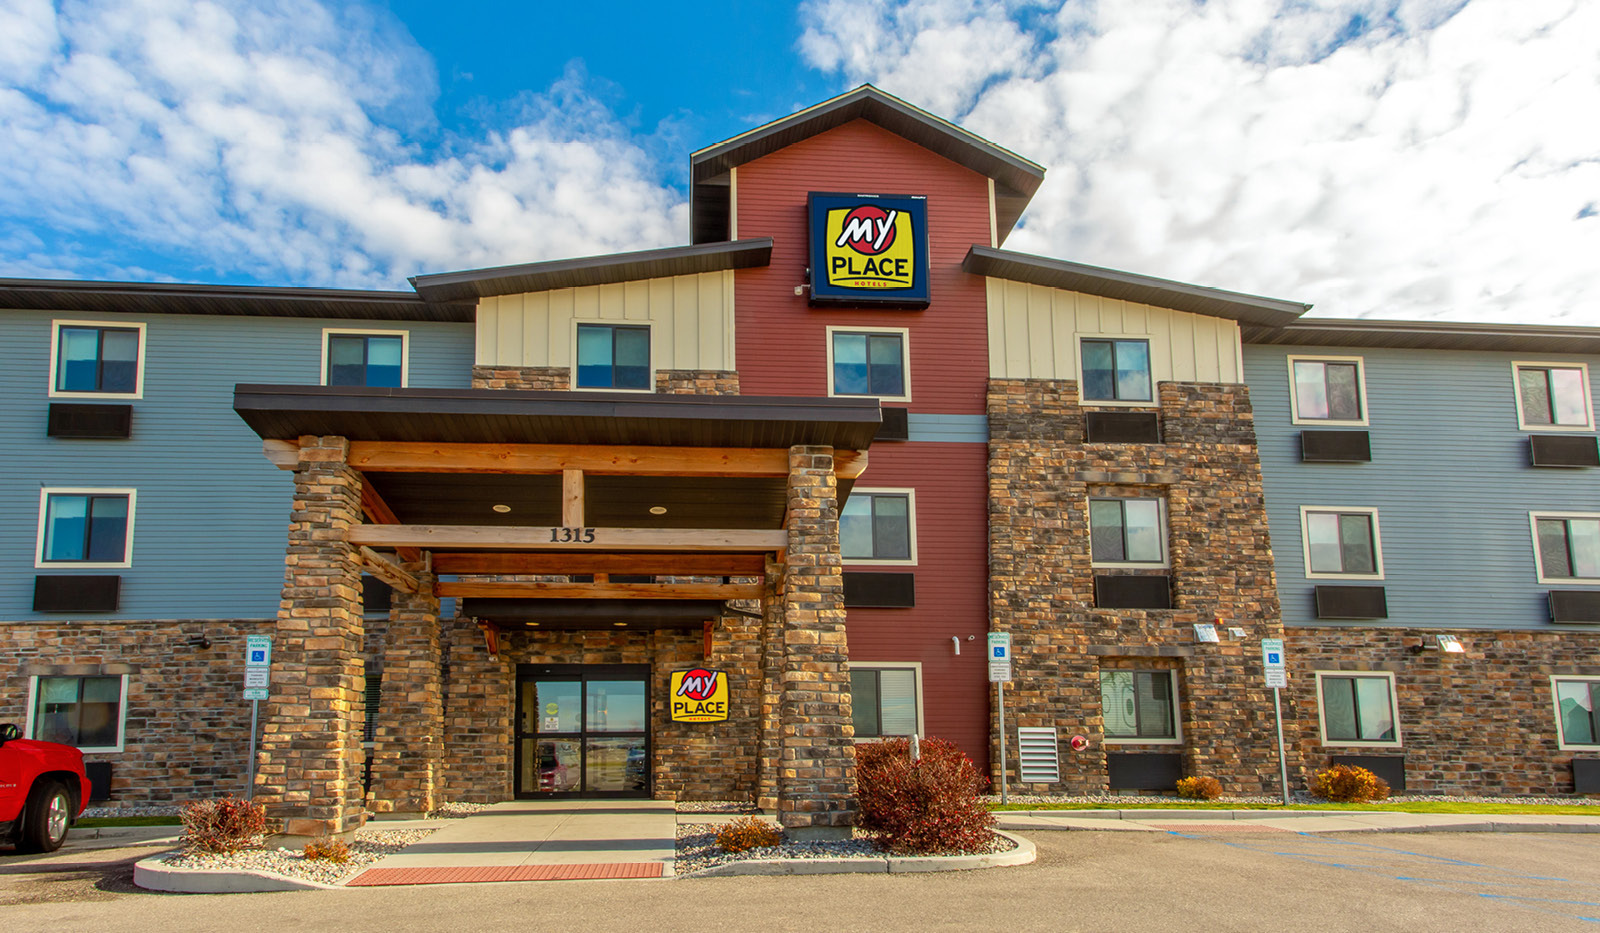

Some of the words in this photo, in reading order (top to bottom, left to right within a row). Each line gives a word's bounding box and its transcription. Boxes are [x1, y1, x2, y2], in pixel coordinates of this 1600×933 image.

[832, 256, 909, 277] PLACE
[550, 527, 595, 543] 1315
[674, 702, 725, 714] PLACE
